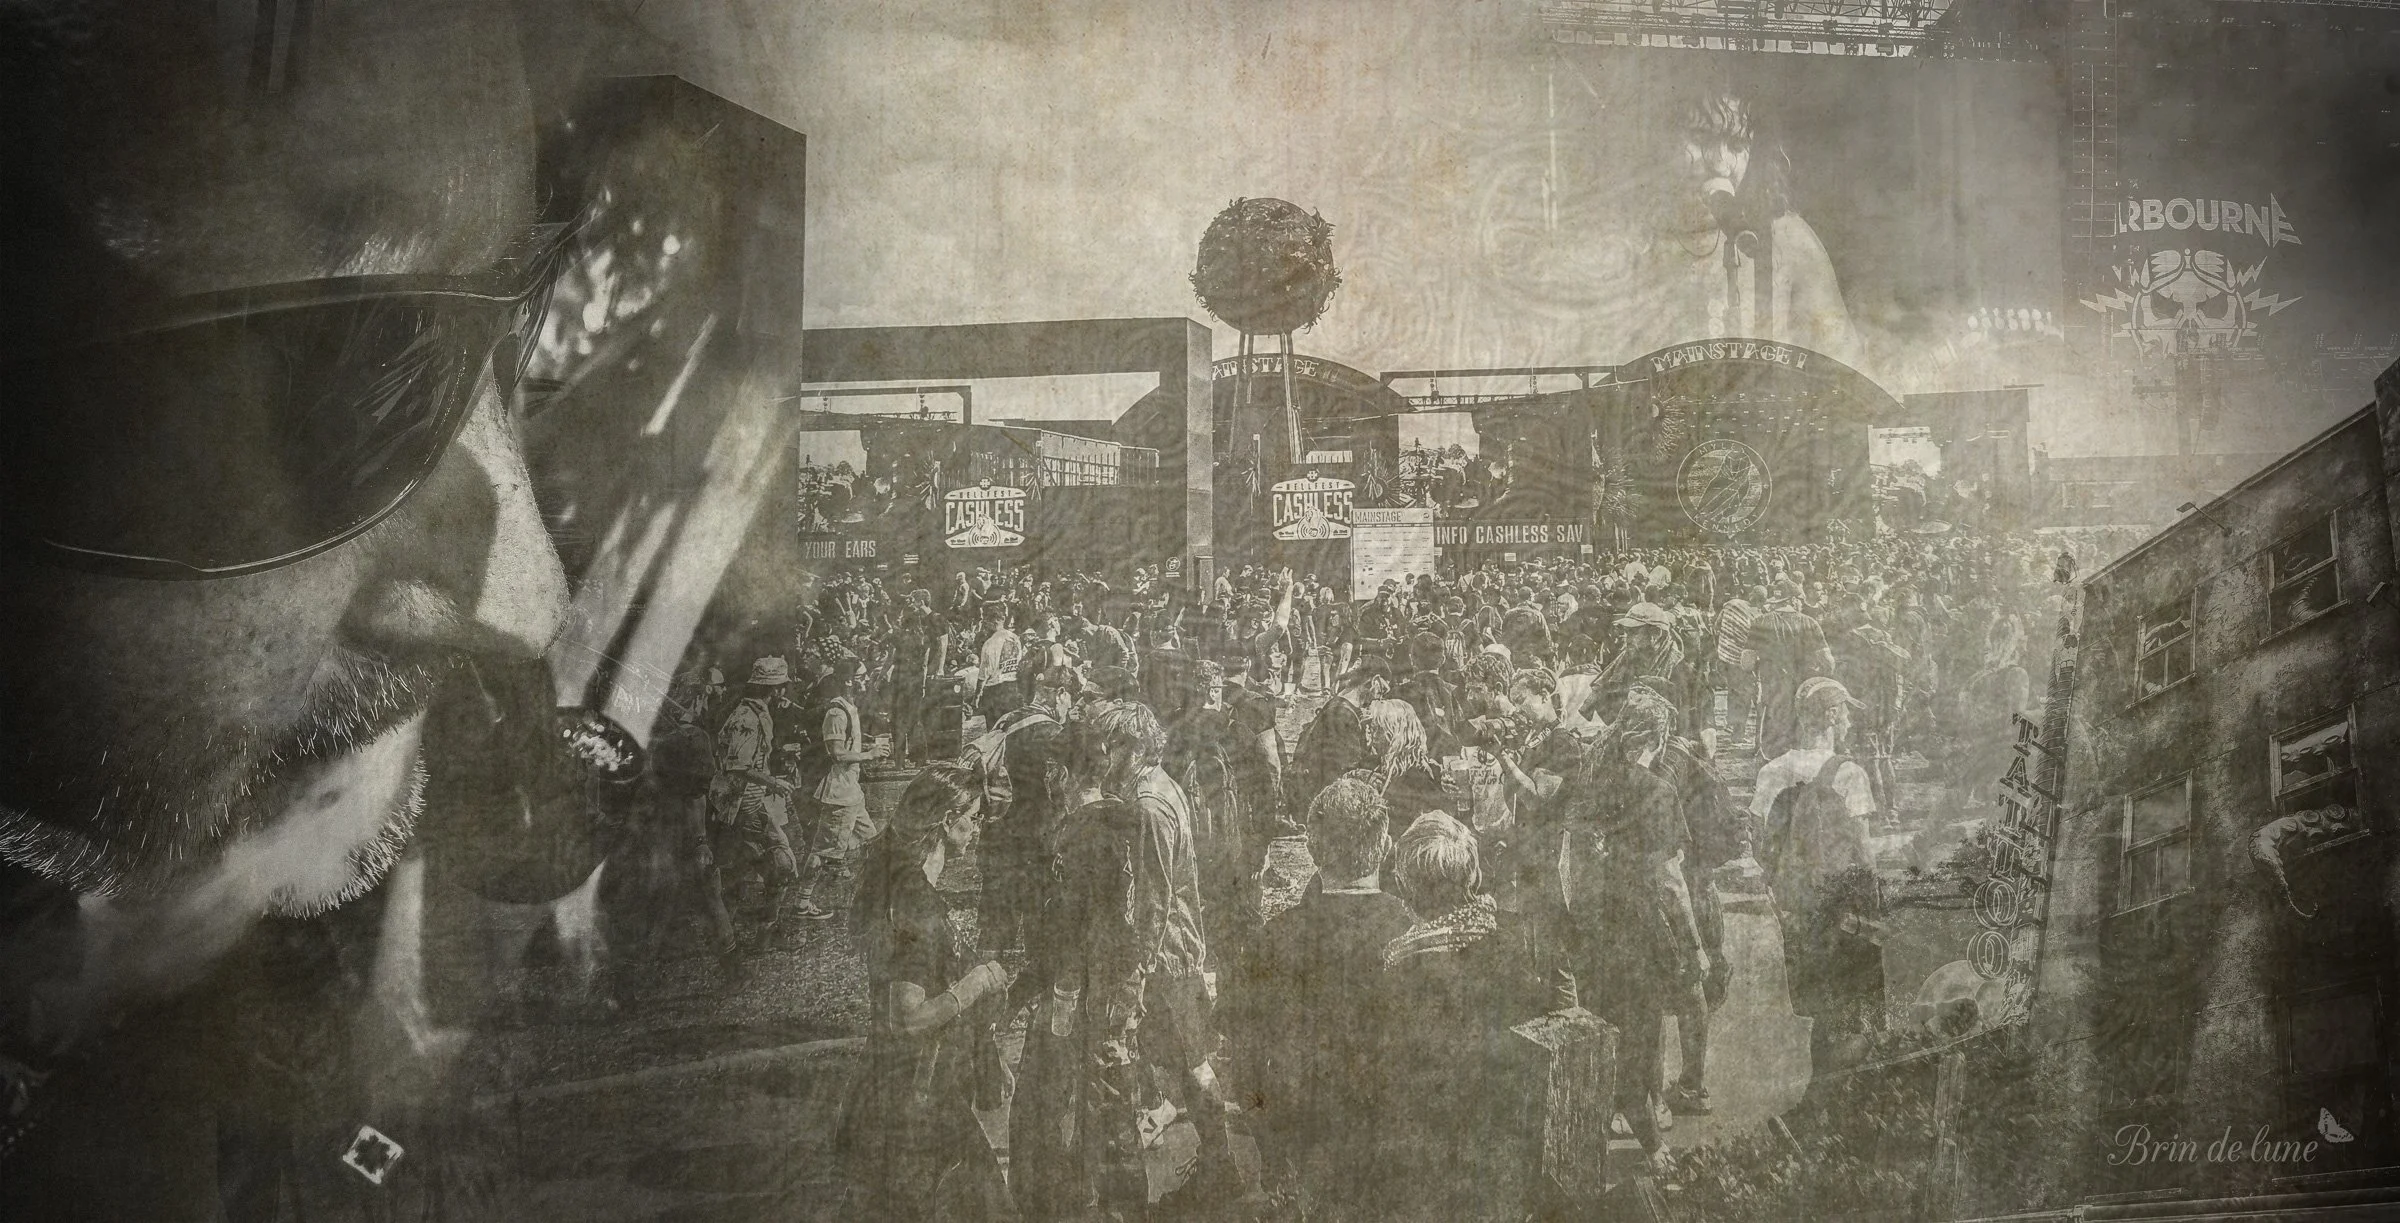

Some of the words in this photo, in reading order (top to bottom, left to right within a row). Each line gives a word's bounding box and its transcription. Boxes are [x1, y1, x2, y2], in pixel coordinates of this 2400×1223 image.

[1651, 342, 1792, 372] MAINSTAGE
[959, 489, 1012, 499] HELLFEST
[1286, 481, 1340, 491] HELLFEST
[945, 499, 1025, 535] CASHLESS
[1272, 491, 1354, 528] CASHLESS
[1354, 511, 1402, 523] MAINSTAGE
[1436, 525, 1468, 545] INFO
[1475, 525, 1549, 545] CASHLESS
[1556, 524, 1584, 543] SAV
[805, 541, 836, 560] YOUR
[845, 540, 876, 558] EARS
[1966, 712, 2042, 982] TATTOO
